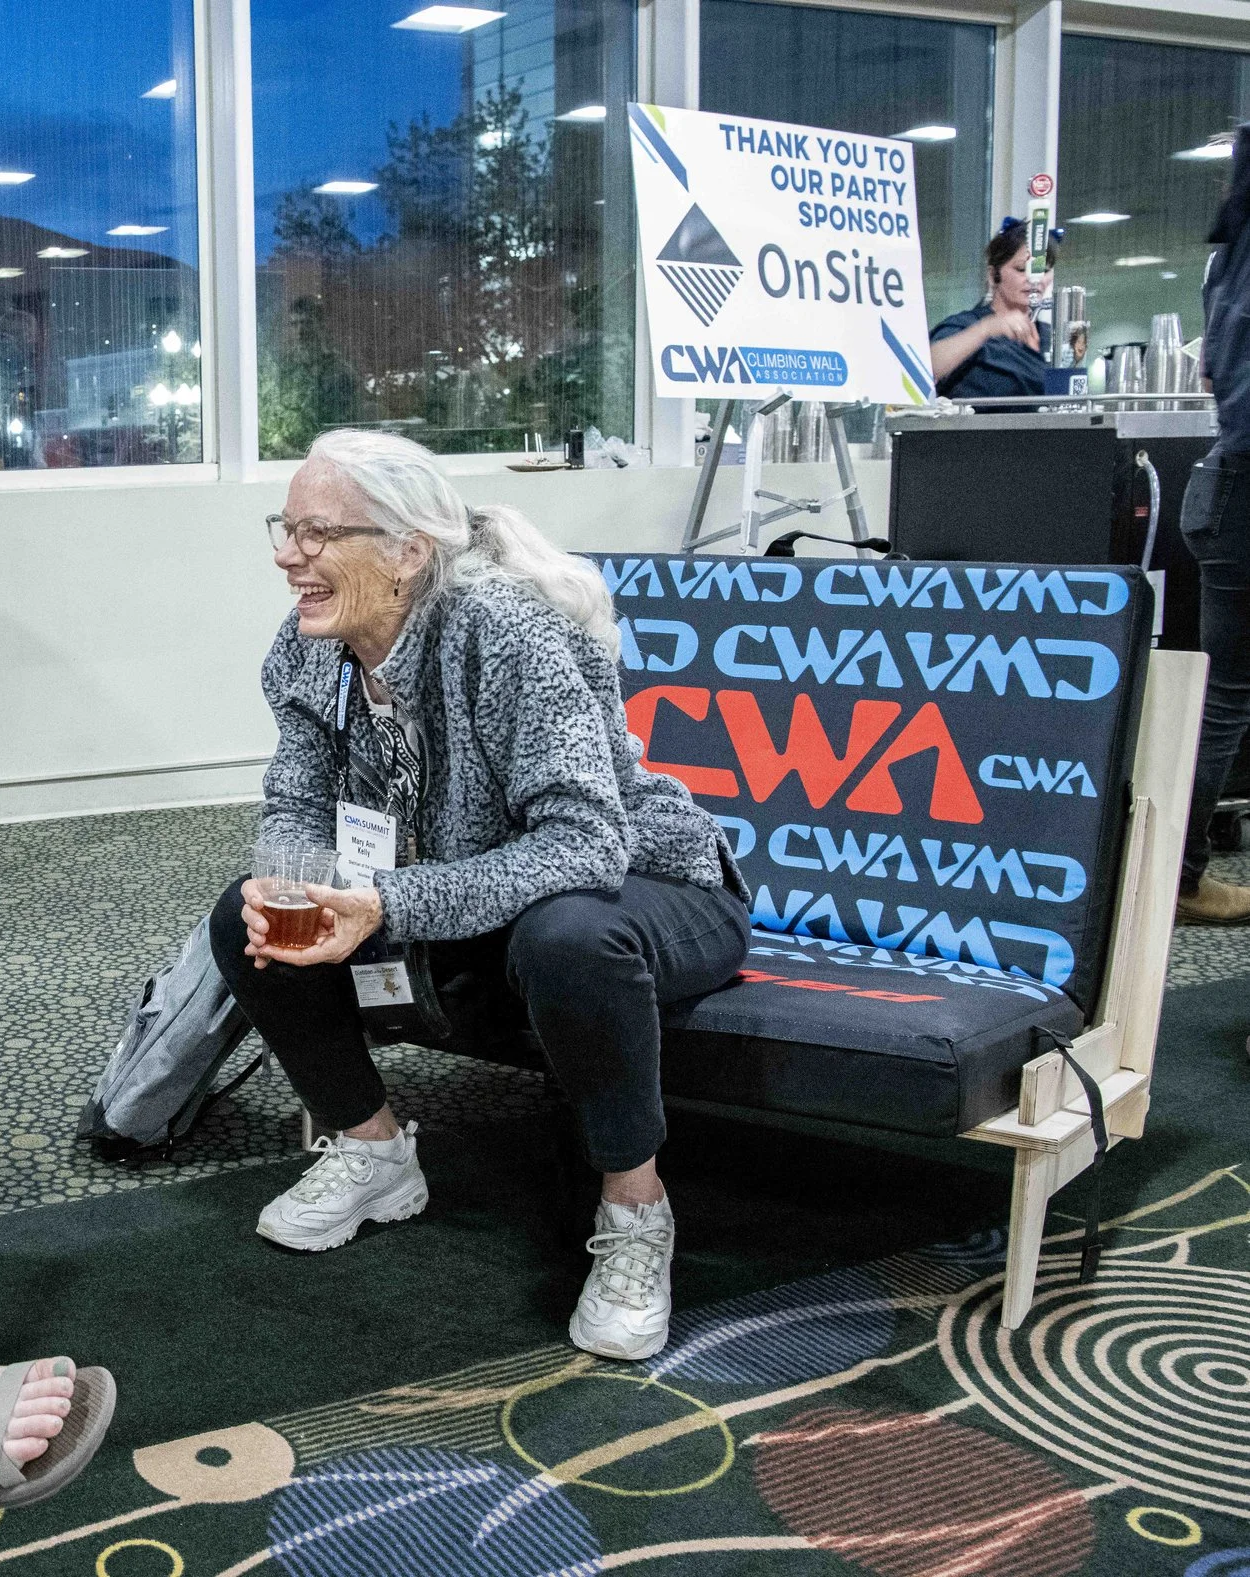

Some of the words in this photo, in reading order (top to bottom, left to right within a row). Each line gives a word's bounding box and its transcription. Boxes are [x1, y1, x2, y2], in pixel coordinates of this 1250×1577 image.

[719, 123, 810, 161] THANK
[817, 137, 868, 169] YOU
[874, 146, 905, 174] TO
[771, 164, 824, 196] OUR
[831, 172, 907, 206] PARTY
[798, 200, 910, 238] SPONSOR
[757, 243, 905, 308] OnSite
[661, 344, 752, 384] CWA
[747, 352, 808, 369] CLIMBING
[810, 355, 843, 371] WALL
[755, 370, 843, 382] ASSOCIATION
[814, 565, 964, 608] CWA
[713, 624, 904, 688] CWA
[623, 685, 985, 825] CWA
[979, 754, 1098, 798] CWA
[768, 824, 919, 882] CWA
